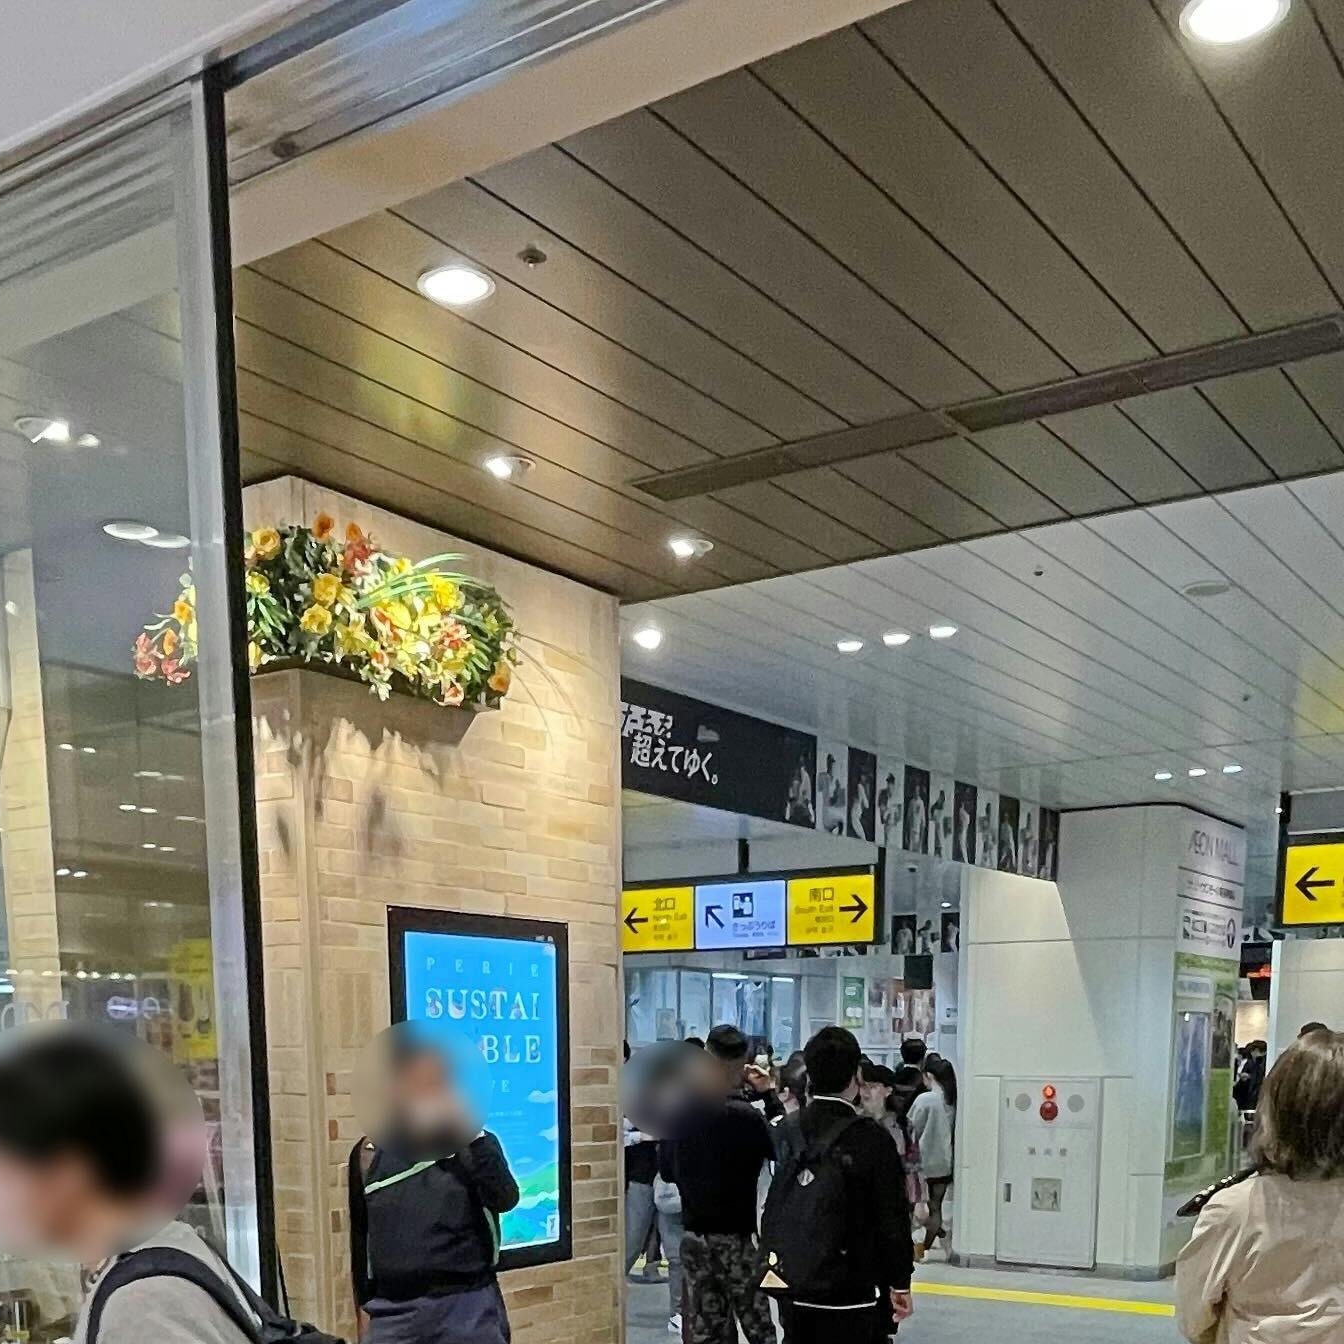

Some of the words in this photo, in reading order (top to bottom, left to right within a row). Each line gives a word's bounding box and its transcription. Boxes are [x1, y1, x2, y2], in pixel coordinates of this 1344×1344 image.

[630, 732, 719, 785] 超えてゆく。
[425, 987, 541, 1021] SUSTAI
[480, 1034, 541, 1064] BLE
